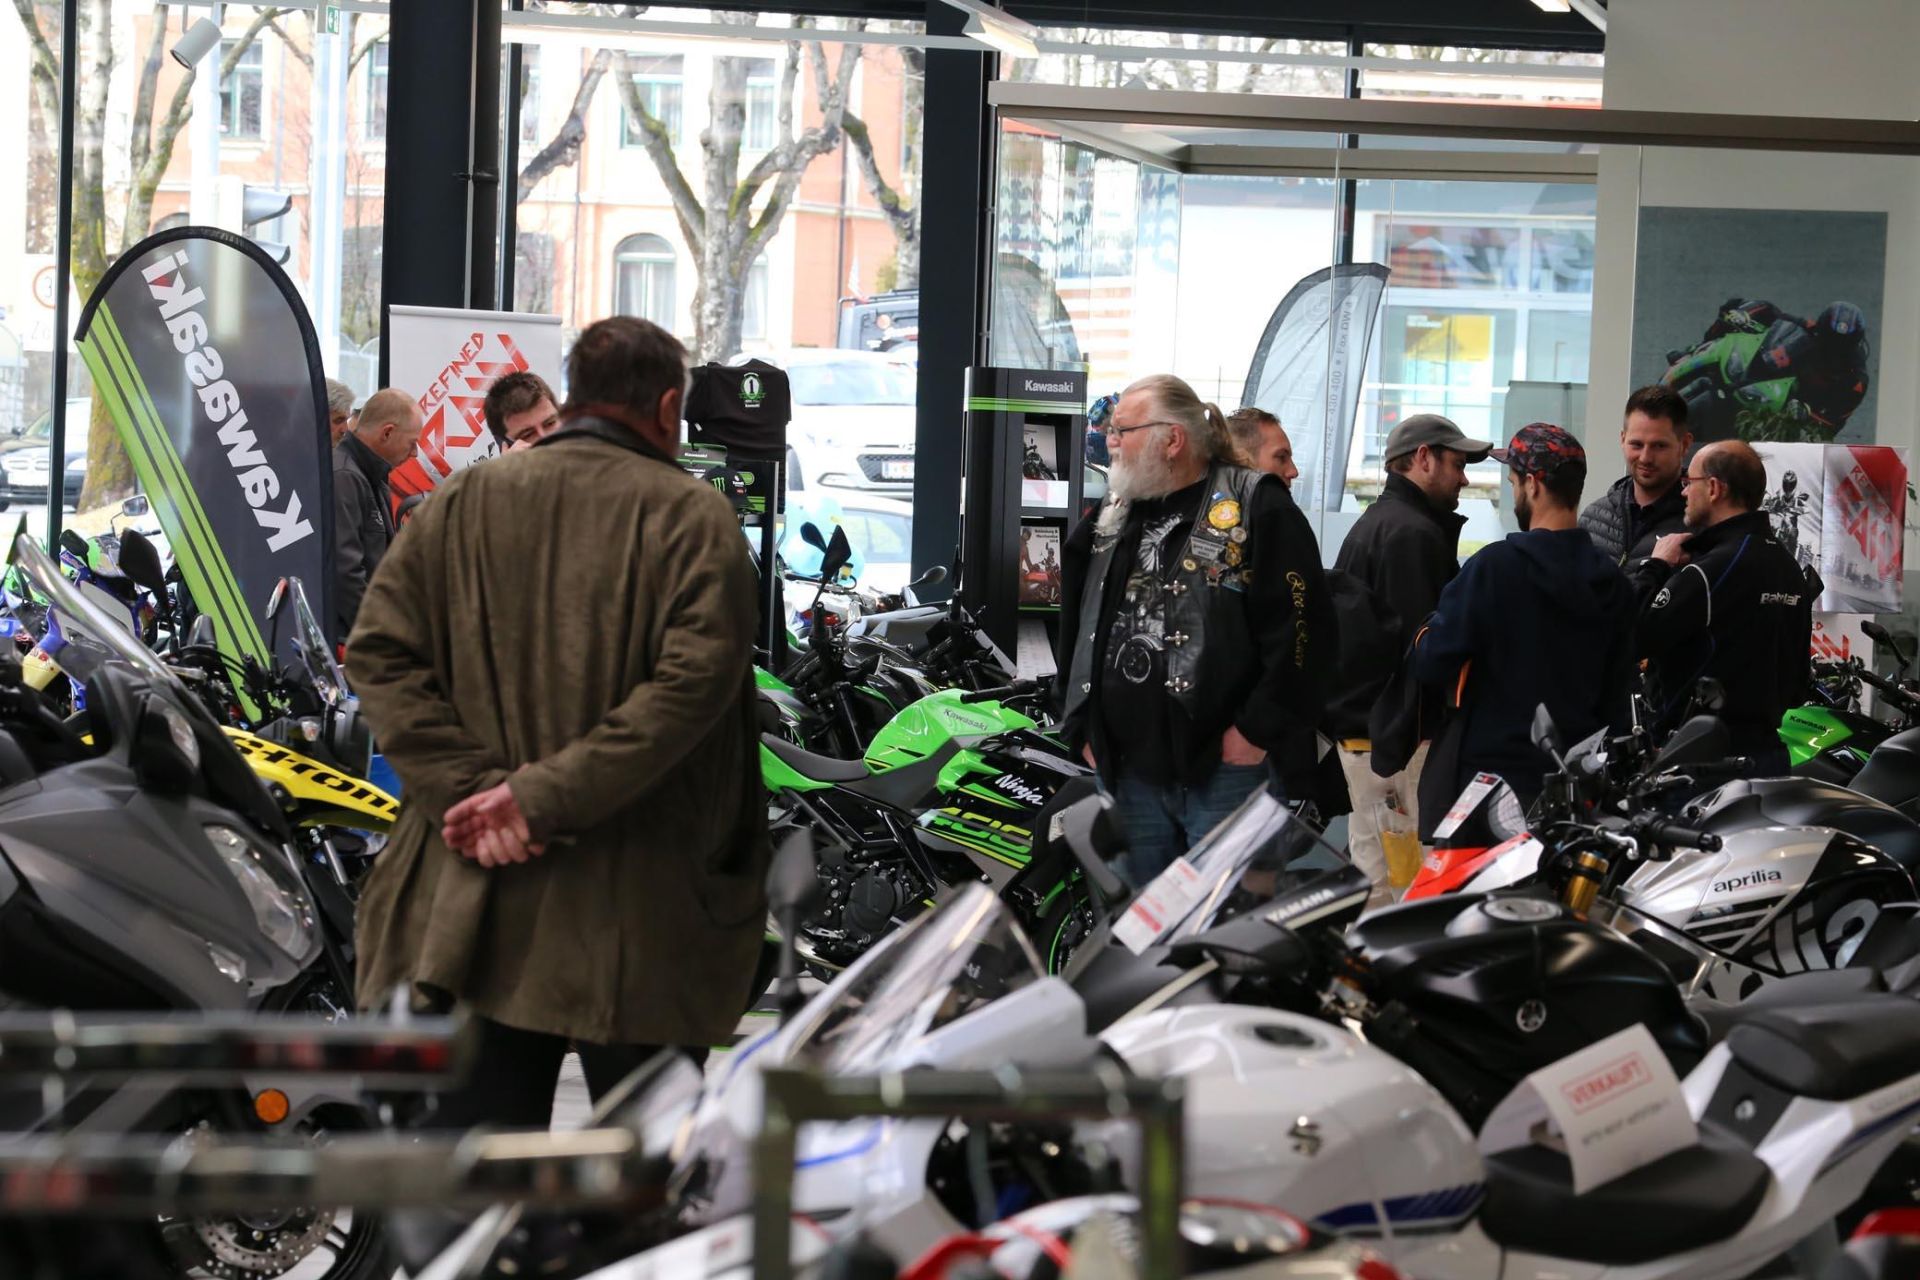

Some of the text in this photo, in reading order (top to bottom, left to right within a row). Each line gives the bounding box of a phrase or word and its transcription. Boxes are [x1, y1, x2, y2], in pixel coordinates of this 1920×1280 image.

[418, 333, 484, 417] REFINED
[1024, 379, 1074, 393] Kawasaki
[943, 708, 988, 732] Kawasaki
[995, 773, 1043, 805] Ninja
[1714, 869, 1782, 893] aprilia
[1265, 889, 1335, 921] YAMAHA
